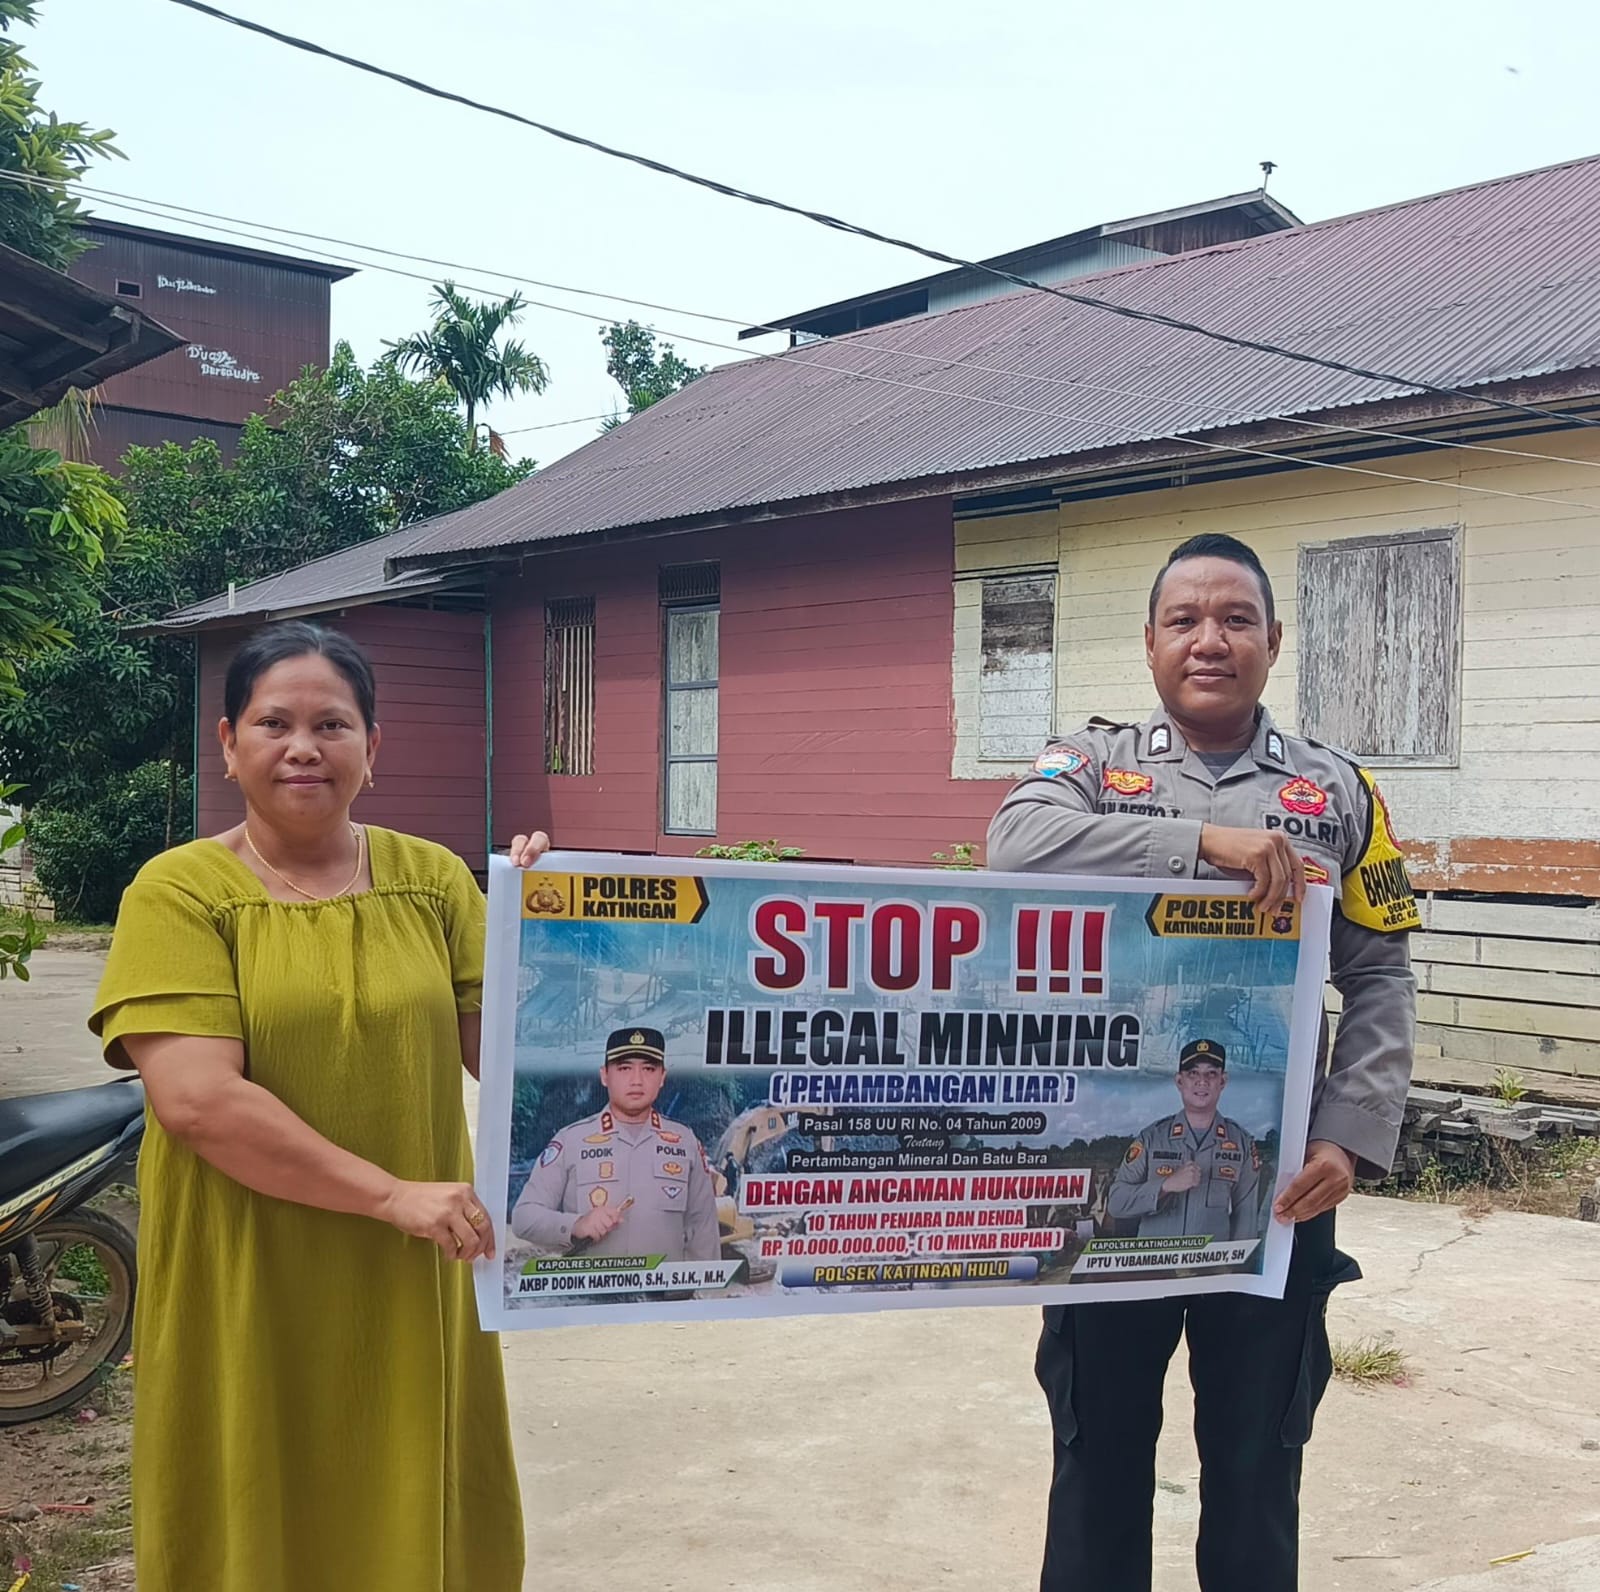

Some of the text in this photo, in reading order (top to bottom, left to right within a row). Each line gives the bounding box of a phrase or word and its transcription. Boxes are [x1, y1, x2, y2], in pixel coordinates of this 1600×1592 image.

[1265, 813, 1339, 846] POLRI
[583, 876, 677, 902] POLRES
[583, 901, 677, 920] KATINGAN
[1165, 899, 1256, 920] POLSEK
[1163, 920, 1255, 936] KATINGAN HULU
[751, 898, 1107, 995] STOP !!!
[705, 1009, 1141, 1068] ILLEGAL MINNING
[804, 1117, 1042, 1131] Pasal 158 UU RI No. 04 Tahun 2009
[656, 1145, 686, 1157] POLRI
[903, 1134, 946, 1151] Tentang
[580, 1147, 613, 1160] DODIK
[791, 1152, 1048, 1169] Pertambangan Mineral Dan Batu Bara
[745, 1174, 1086, 1207] DENGAN ANCAMAN HUKUMAN
[807, 1209, 1025, 1232] 10 TAHUN PENJARA DAN DENDA
[761, 1240, 783, 1257] RP.
[948, 1233, 998, 1250] MILYAR
[1091, 1238, 1204, 1250] KAPOLSEK KATINGAN HULU
[537, 1257, 646, 1271] KAPOLRES KATINGAN
[1086, 1249, 1246, 1269] IPTU YUBAMBANG KUSNADY, SH
[518, 1276, 549, 1293] AKBP
[551, 1275, 586, 1291] DODIK
[588, 1273, 643, 1290] HARTONO,
[645, 1272, 669, 1287] S.H.,
[703, 1270, 726, 1284] M.H.
[814, 1261, 1009, 1283] POLSEK KATINGAN HULU
